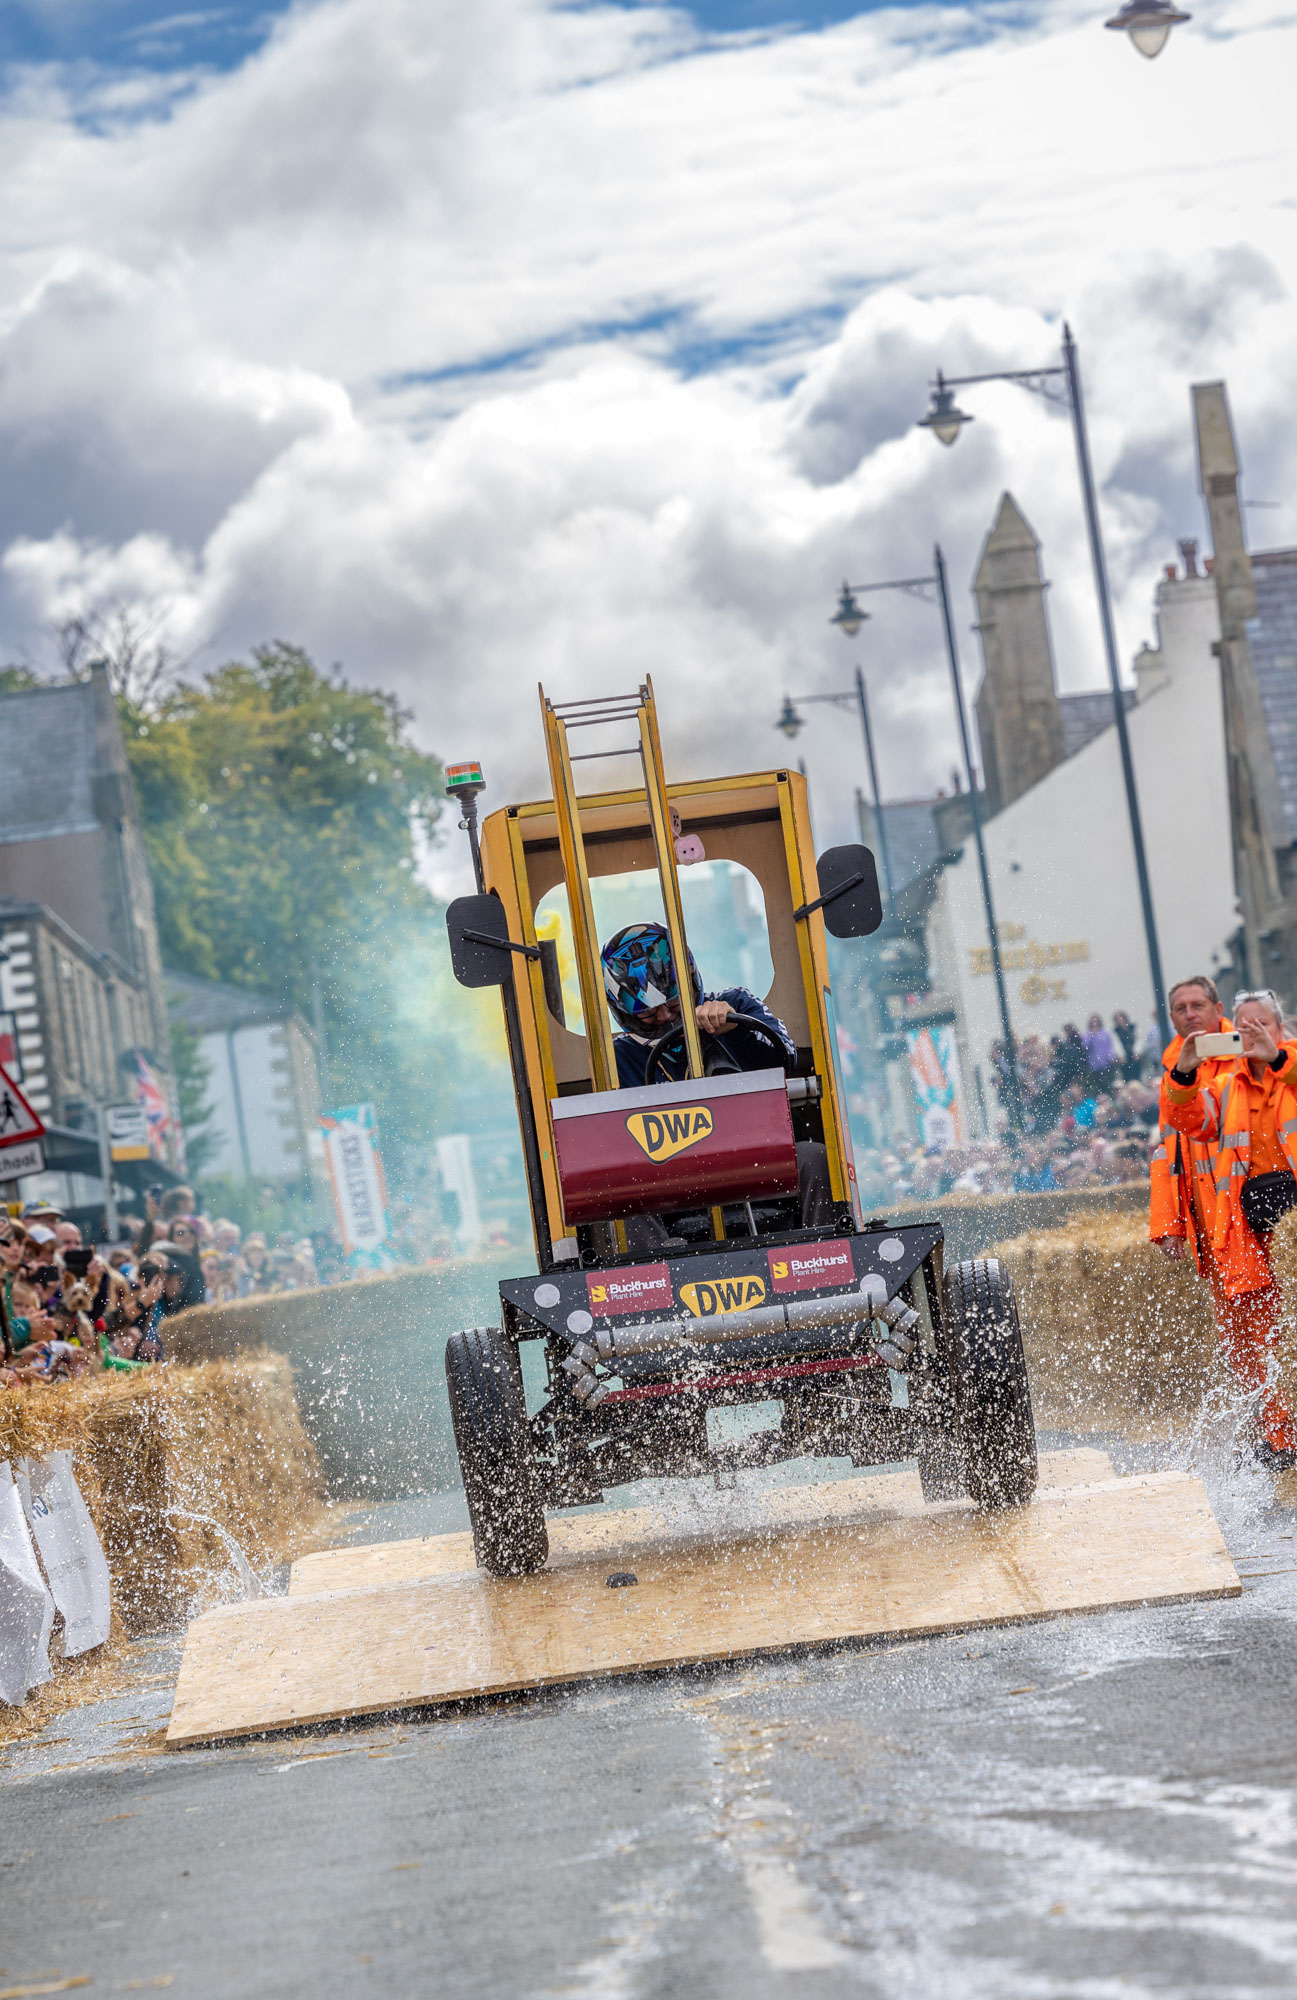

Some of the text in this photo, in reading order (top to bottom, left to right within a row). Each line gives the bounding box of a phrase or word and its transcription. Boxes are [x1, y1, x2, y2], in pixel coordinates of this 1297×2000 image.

[642, 1113, 711, 1153] DWA
[791, 1253, 848, 1270] Buckhurst
[792, 1267, 825, 1277] Plant Hire
[609, 1278, 667, 1294] Buckhurst
[611, 1291, 644, 1301] Plant Hire
[695, 1281, 765, 1316] DWA
